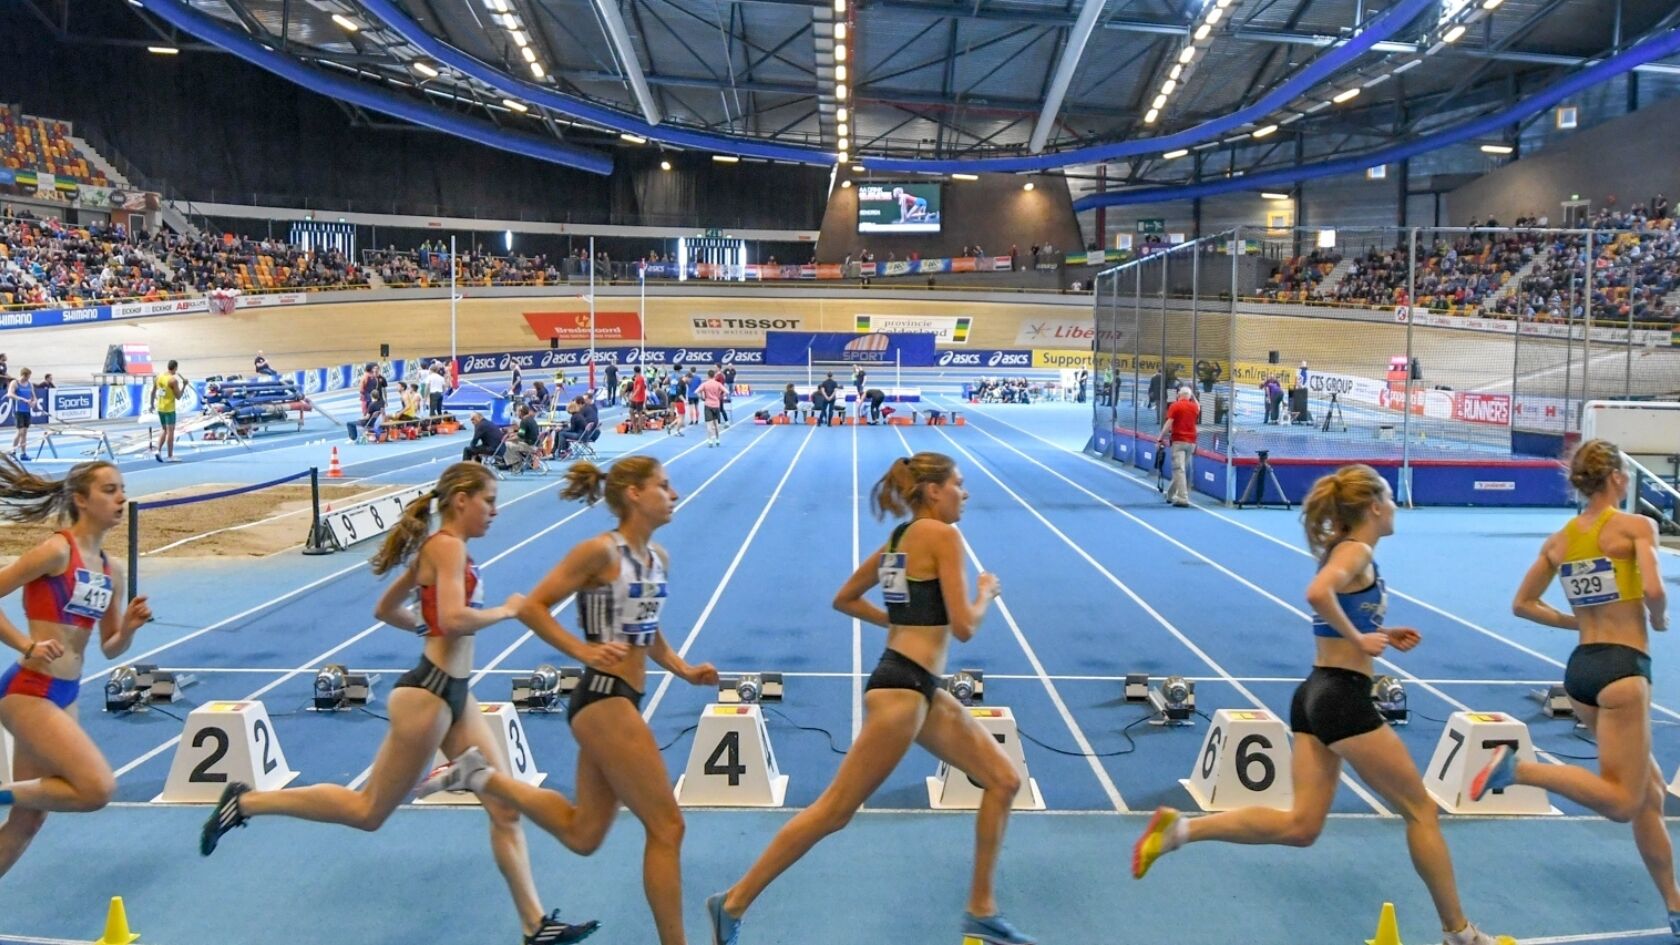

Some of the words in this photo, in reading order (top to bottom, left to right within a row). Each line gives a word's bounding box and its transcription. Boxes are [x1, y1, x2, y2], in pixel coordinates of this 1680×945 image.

[0, 313, 33, 326] HIMANO
[62, 308, 98, 321] SHIMANO
[723, 319, 799, 329] TISSOT
[885, 319, 932, 327] provincie
[474, 358, 496, 369] asics
[553, 353, 576, 364] asics
[685, 351, 714, 362] asics
[735, 351, 762, 362] asics
[842, 352, 886, 361] SPORT
[953, 353, 980, 364] asics
[1001, 354, 1028, 365] asics
[1326, 377, 1353, 393] GROUP
[58, 396, 90, 409] Sports
[1465, 399, 1508, 422] RUNNERS
[342, 514, 357, 540] 9
[370, 505, 384, 529] 8
[1570, 576, 1602, 596] 329
[84, 588, 107, 609] 413
[254, 719, 277, 775] 2
[509, 719, 526, 774] 3
[1202, 726, 1222, 780] 6
[189, 727, 229, 783] 2
[704, 731, 747, 786] 4
[1439, 728, 1465, 781] 7
[1235, 733, 1276, 792] 6
